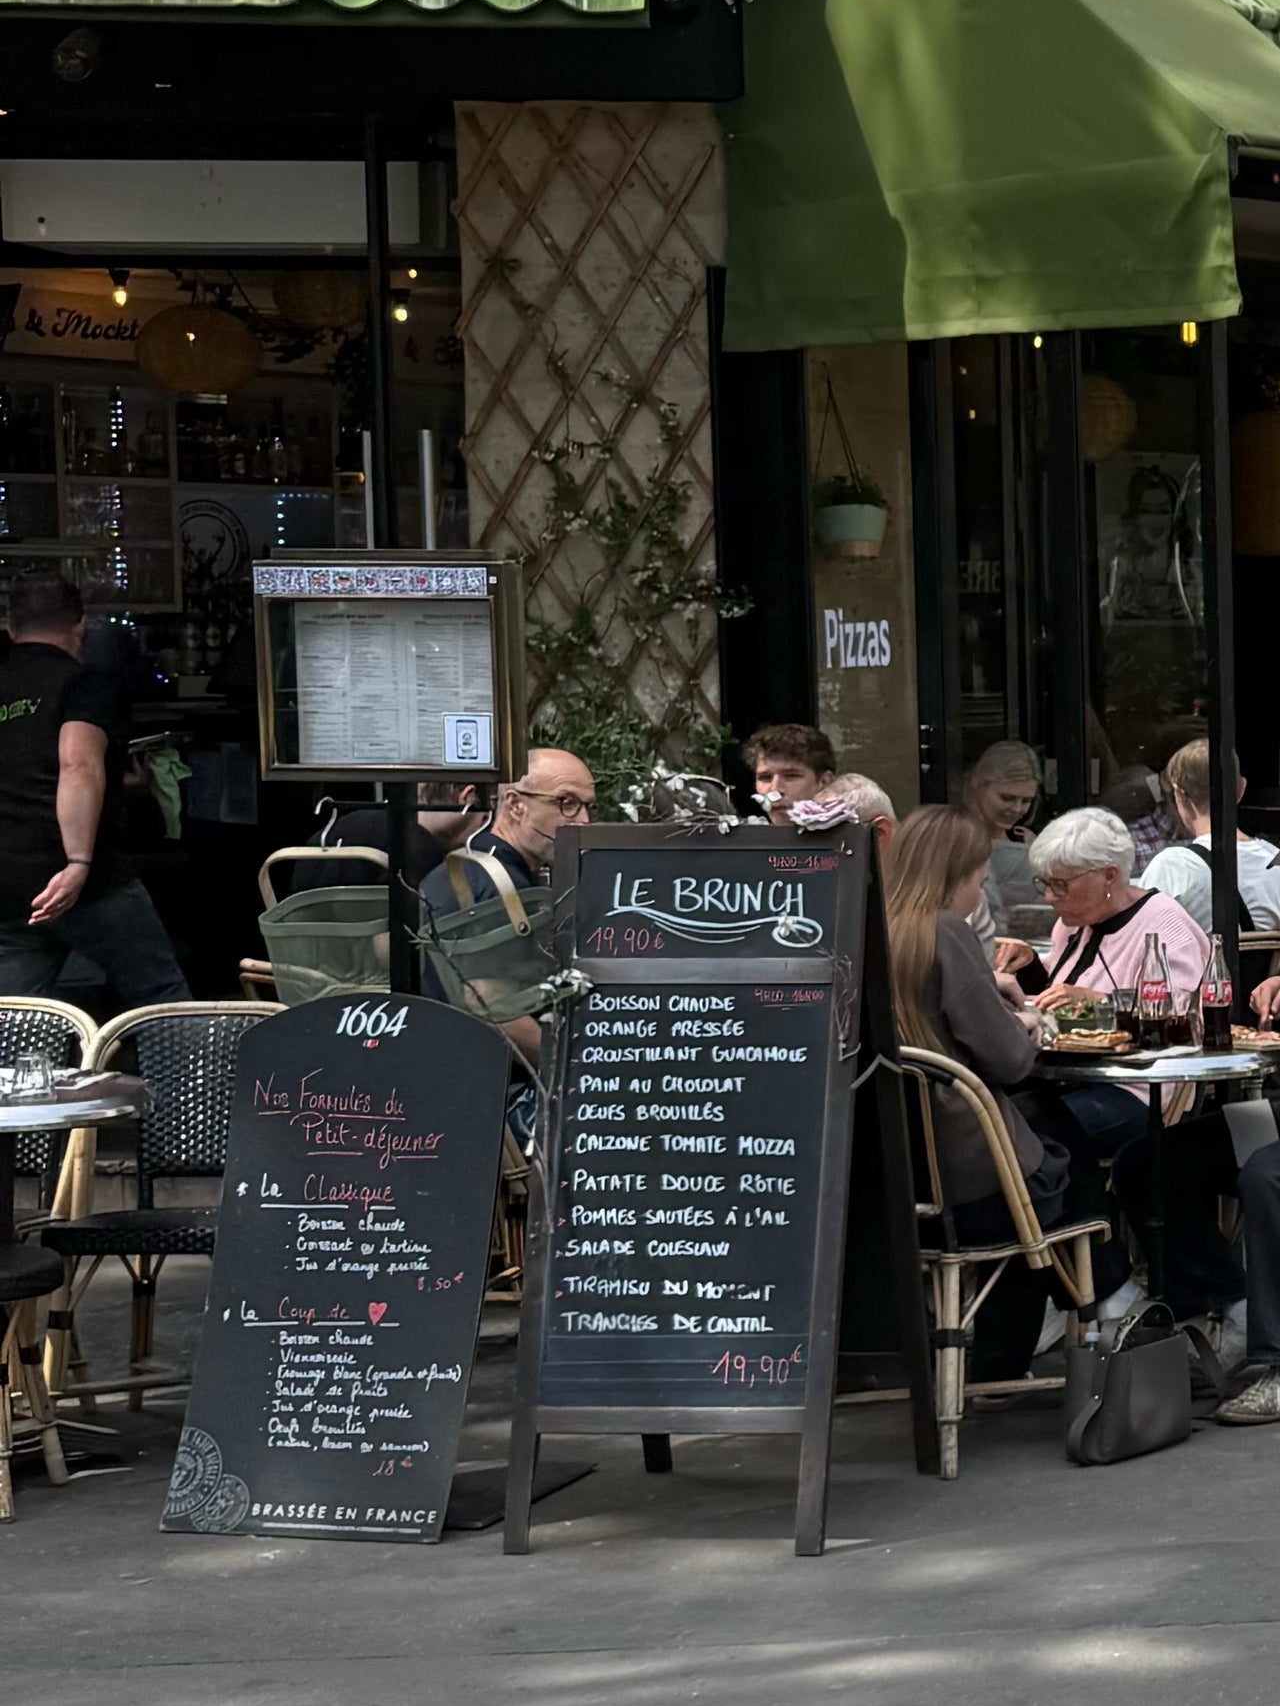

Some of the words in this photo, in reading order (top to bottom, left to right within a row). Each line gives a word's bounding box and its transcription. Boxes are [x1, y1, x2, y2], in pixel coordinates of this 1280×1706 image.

[824, 608, 892, 669] Pizzas
[613, 872, 655, 909] LE
[673, 876, 804, 918] BRUNCH
[586, 926, 665, 957] 19,90€
[589, 992, 660, 1011] BOISSON
[668, 995, 736, 1012] CHAUDE
[336, 1000, 410, 1037] 1664
[585, 1020, 657, 1038] ORANGE
[671, 1019, 746, 1037] PRESSÉE
[582, 1046, 702, 1064] CROUSTILLANT
[712, 1046, 808, 1063] GUACAMOLE
[579, 1074, 620, 1093] PAIN
[629, 1077, 652, 1093] AU
[662, 1075, 747, 1093] CHOCOLAT
[385, 1088, 405, 1115] du
[577, 1103, 626, 1122] OEUFS
[636, 1101, 726, 1122] BROUILLÉS
[575, 1133, 652, 1154] CALZONE
[660, 1134, 727, 1154] TOMATE
[738, 1135, 796, 1156] MOZZA
[304, 1173, 395, 1212] Classique
[572, 1168, 648, 1192] PATATE
[661, 1173, 726, 1192] DOUCE
[739, 1173, 796, 1195] RÔTIE
[298, 1212, 346, 1232] Boisson
[358, 1212, 406, 1232] chaude
[571, 1204, 637, 1226] POMMES
[645, 1206, 715, 1227] SAUTÉES
[744, 1207, 790, 1227] L'AIL
[297, 1236, 354, 1252] Croissant
[379, 1237, 432, 1255] tartine
[564, 1239, 636, 1257] SALADE
[647, 1240, 730, 1257] COLESLAW
[295, 1256, 318, 1271] Jus
[325, 1257, 380, 1280] d'orange
[386, 1256, 430, 1275] pressée
[562, 1275, 650, 1298] TIRAMISU
[664, 1279, 689, 1297] DU
[277, 1296, 316, 1325] Coup
[326, 1303, 350, 1321] de
[560, 1311, 659, 1333] TRANCHES
[673, 1313, 702, 1333] DE
[707, 1315, 775, 1334] CANTAL
[279, 1330, 320, 1346] Boisson
[328, 1329, 374, 1346] chaude
[280, 1348, 357, 1365] Viennoiserie
[711, 1344, 802, 1388] 19,90€
[277, 1364, 326, 1386] Fromage
[333, 1365, 363, 1380] blanc
[275, 1379, 316, 1397] Salade
[325, 1386, 343, 1397] de
[350, 1383, 389, 1403] fruits
[271, 1400, 294, 1413] Jus
[299, 1400, 361, 1423] d'orange
[312, 1416, 366, 1435] brouillés
[251, 1502, 327, 1520] BRASSÉE
[335, 1506, 359, 1520] EN
[365, 1508, 438, 1524] FRANCE
